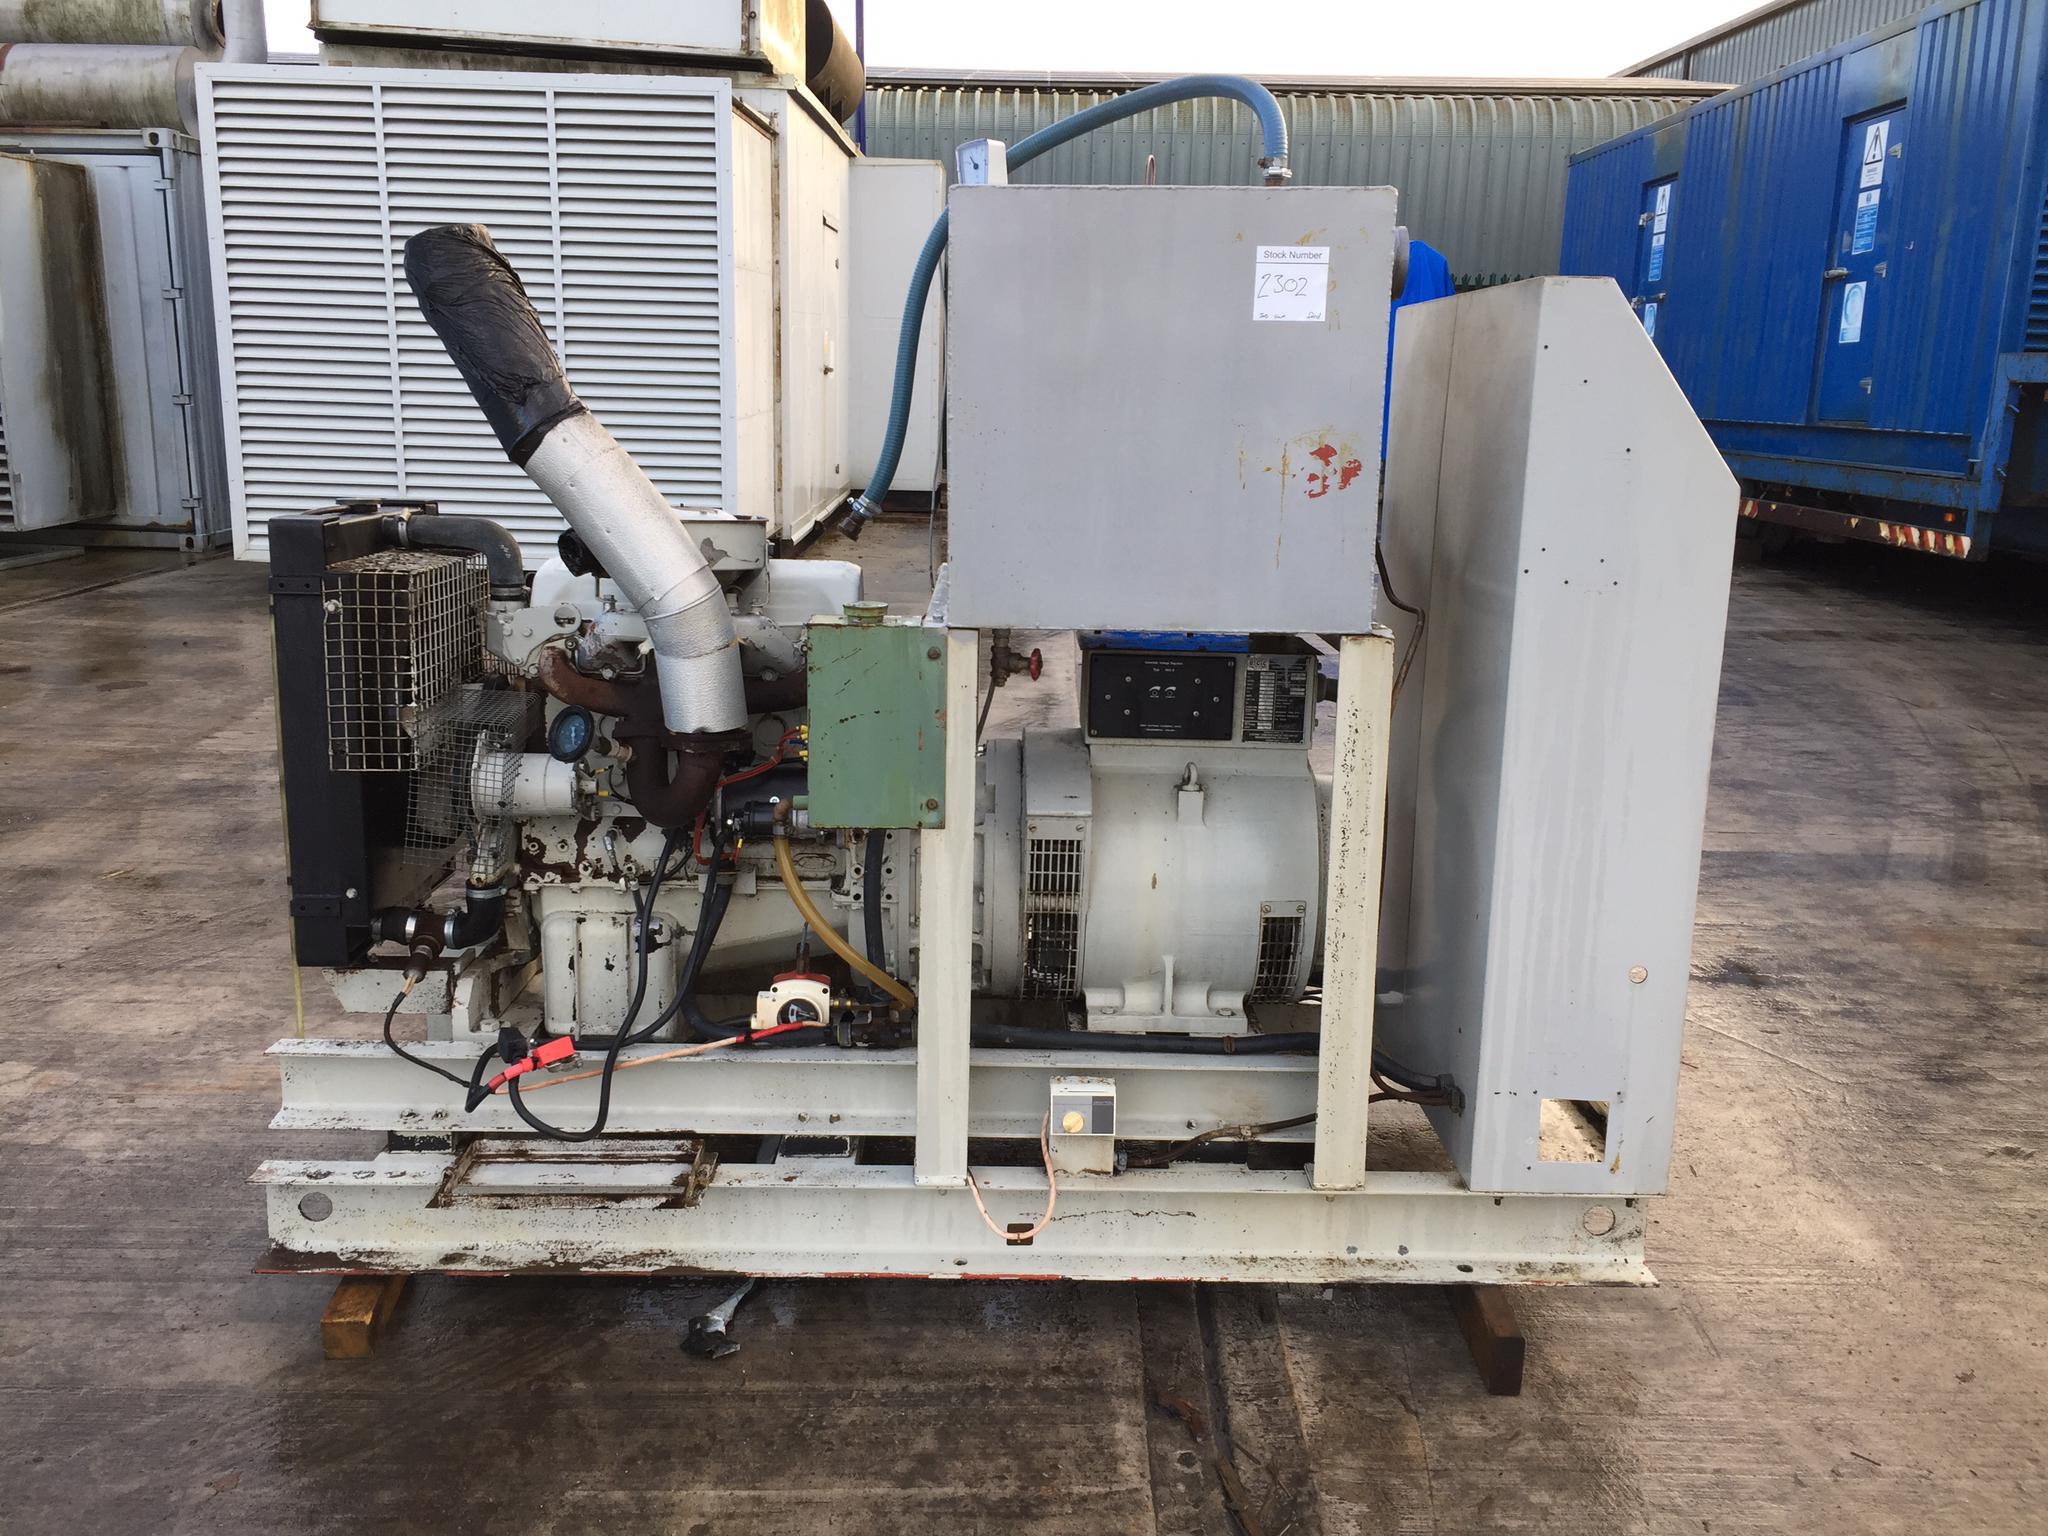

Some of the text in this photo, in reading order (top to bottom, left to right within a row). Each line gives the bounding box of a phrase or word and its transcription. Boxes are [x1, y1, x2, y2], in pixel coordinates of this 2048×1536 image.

[1263, 250, 1323, 260] Stock Number
[1257, 273, 1308, 299] 2302
